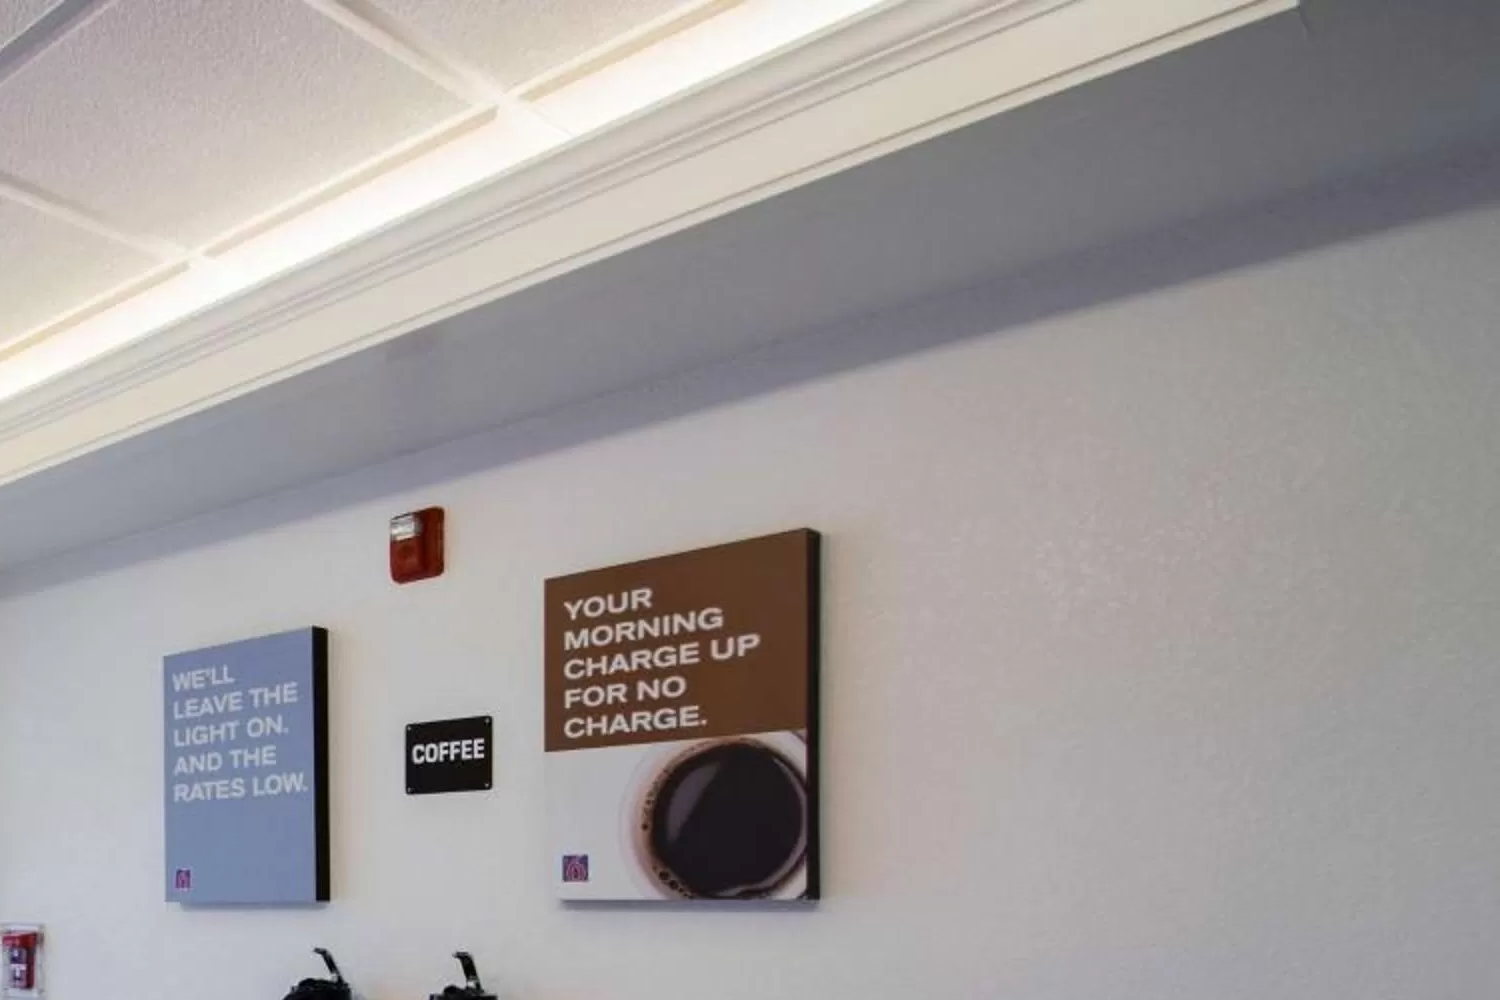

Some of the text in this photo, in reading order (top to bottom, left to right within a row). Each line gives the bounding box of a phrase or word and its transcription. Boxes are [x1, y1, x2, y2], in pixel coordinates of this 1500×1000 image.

[563, 587, 653, 621] YOUR
[563, 607, 724, 650] MORNING
[563, 633, 760, 680] CHARGE UP
[172, 664, 236, 692] WE'LL
[564, 675, 687, 709] FOR NO
[173, 681, 298, 720] LEAVE THE
[173, 713, 289, 747] LIGHT ON.
[563, 705, 708, 739] CHARGE.
[173, 744, 277, 776] AND THE
[412, 737, 485, 765] COFFEE
[173, 771, 309, 803] RATES LOW.
